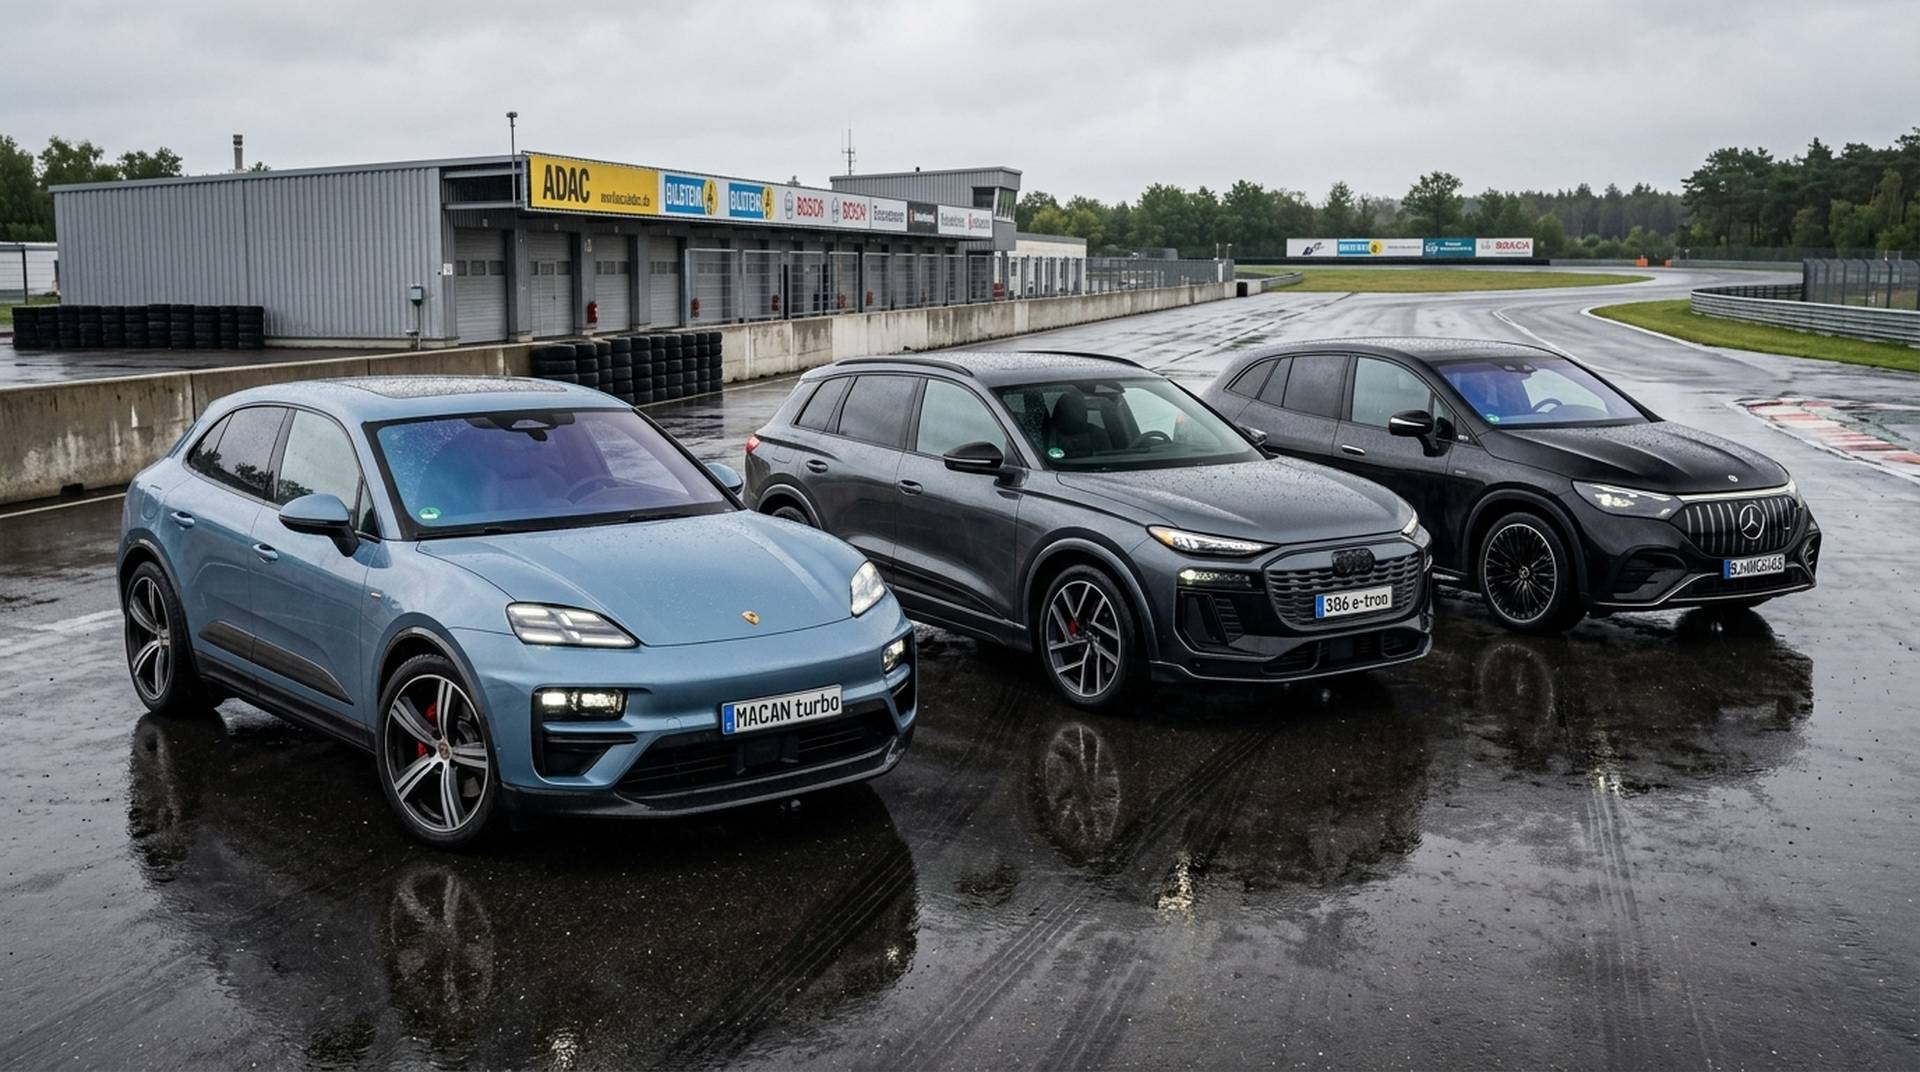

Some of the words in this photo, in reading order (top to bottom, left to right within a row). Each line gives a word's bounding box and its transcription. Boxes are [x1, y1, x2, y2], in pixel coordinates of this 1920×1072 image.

[543, 164, 590, 204] ADAC
[1325, 596, 1349, 613] 386
[736, 700, 791, 728] MACAN
[795, 693, 839, 718] turbo
